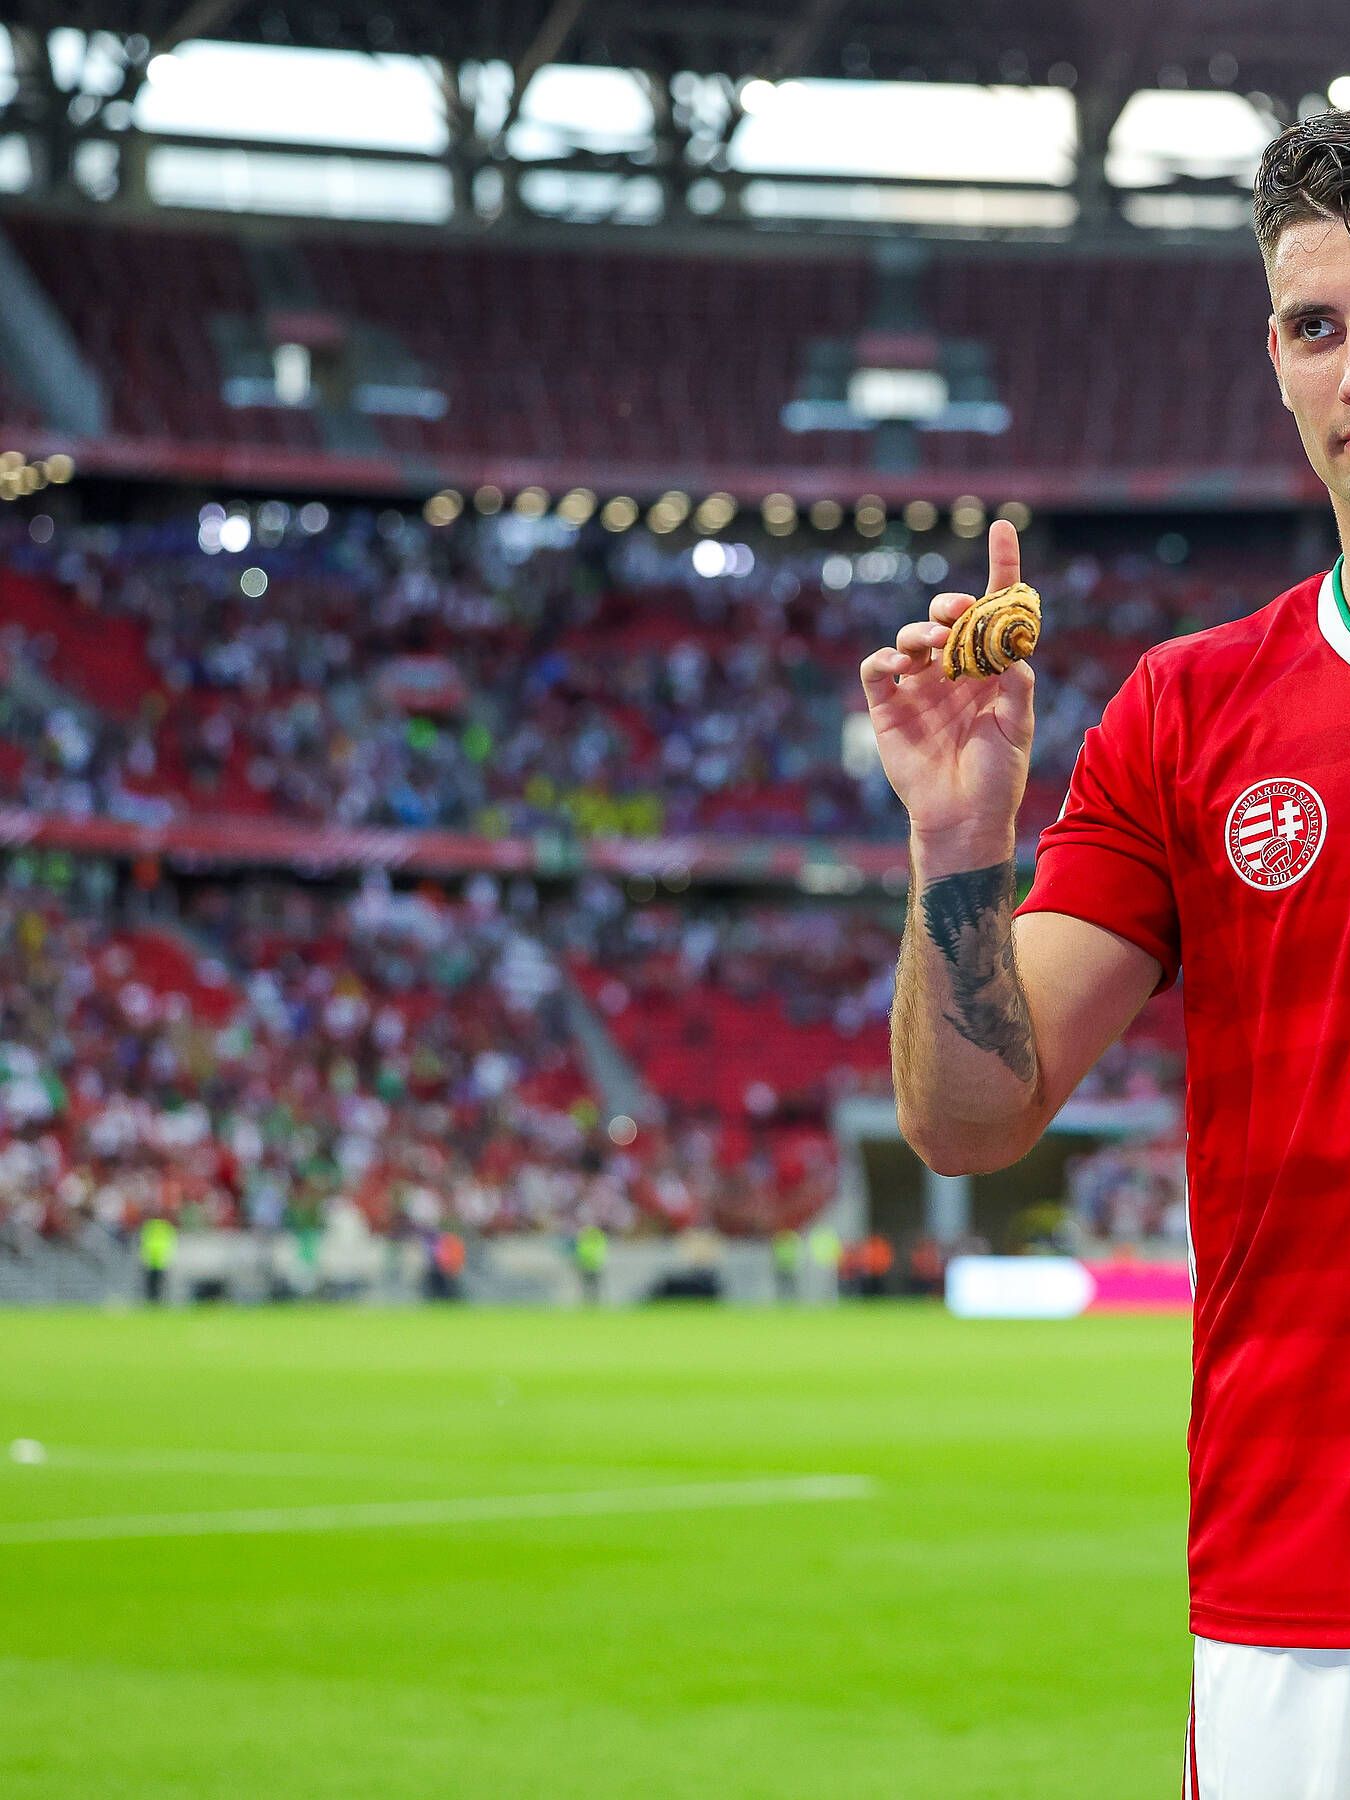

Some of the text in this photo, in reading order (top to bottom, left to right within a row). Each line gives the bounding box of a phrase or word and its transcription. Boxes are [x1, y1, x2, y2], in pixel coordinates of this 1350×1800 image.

[1230, 783, 1319, 880] MAGYAR LABDARÚGÓ SZÖVETSÉG
[1266, 870, 1294, 886] 1901
